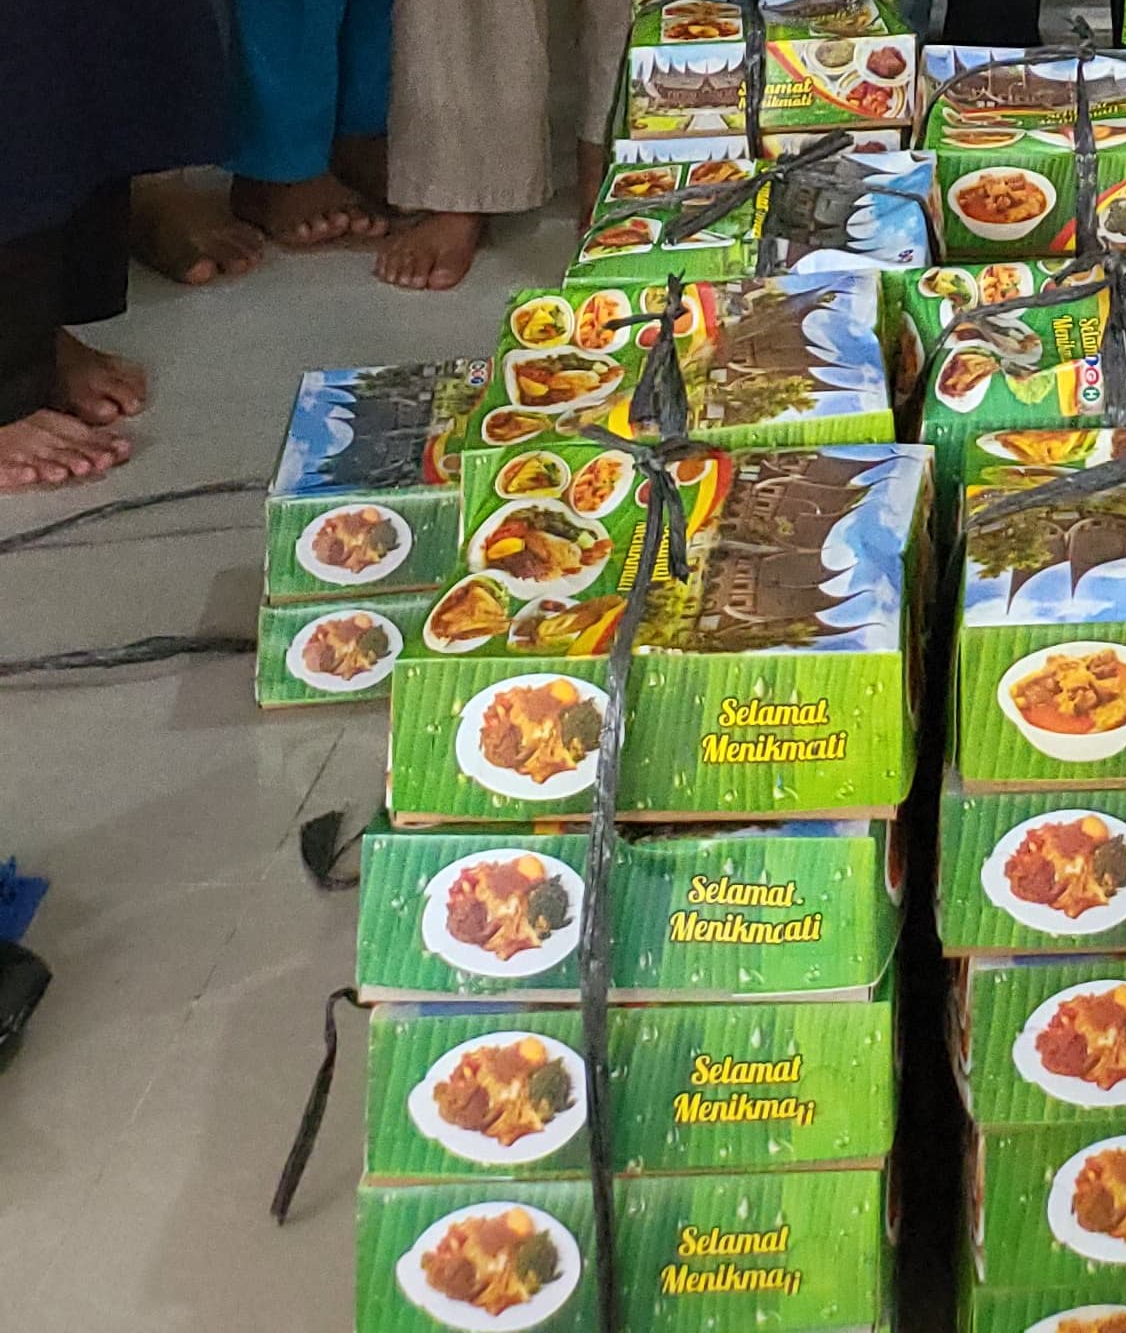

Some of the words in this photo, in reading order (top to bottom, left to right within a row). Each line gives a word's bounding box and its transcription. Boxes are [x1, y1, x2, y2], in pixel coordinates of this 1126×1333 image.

[719, 697, 830, 727] Selamat
[702, 731, 848, 763] Menikmati
[688, 874, 804, 907] Selamat
[690, 1054, 803, 1085] Selamat
[673, 1092, 816, 1126] Menikmati
[677, 1225, 790, 1256] Selamat
[660, 1263, 802, 1296] Menikmati
